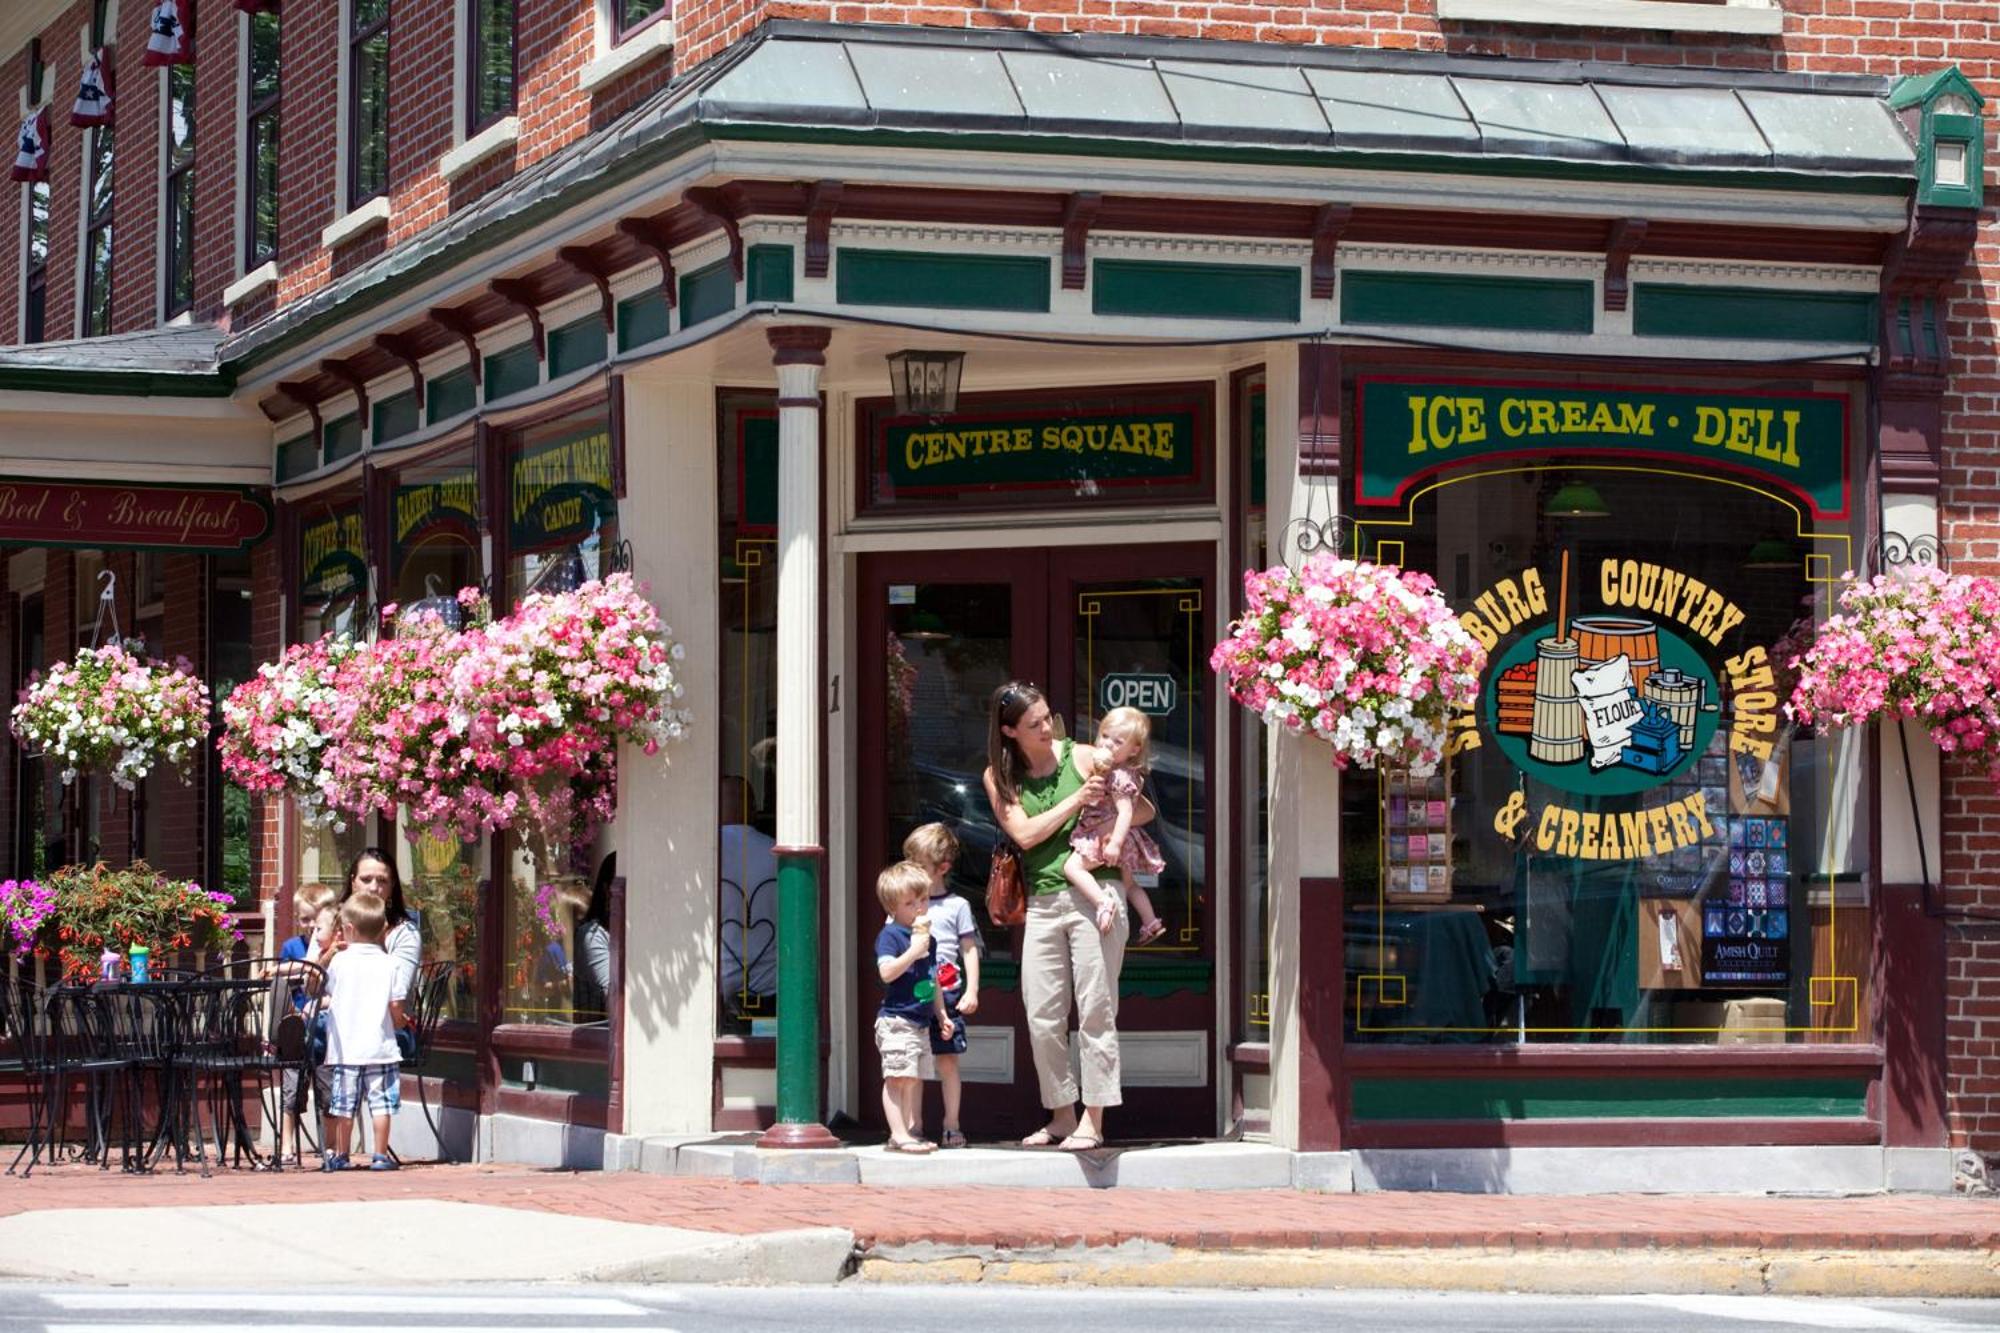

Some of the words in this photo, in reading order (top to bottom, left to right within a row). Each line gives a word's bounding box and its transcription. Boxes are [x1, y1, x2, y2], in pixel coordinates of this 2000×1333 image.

[905, 428, 1033, 470] CENTRE
[1041, 422, 1175, 460] SQUARE
[1407, 395, 1487, 455] ICE
[1499, 398, 1657, 437] CREAM
[1693, 406, 1801, 468] DELI
[513, 445, 570, 523] COUNTRY
[0, 486, 50, 521] Bed
[62, 489, 88, 531] &
[108, 490, 238, 543] Breakfast
[543, 496, 582, 533] CANDY
[1600, 557, 1746, 648] COUNTRY
[1724, 645, 1778, 762] STORE
[829, 674, 840, 714] 1
[1106, 678, 1170, 708] OPEN
[1592, 699, 1639, 729] FLOUR
[1493, 790, 1528, 840] &
[1535, 790, 1715, 860] CREAMERY
